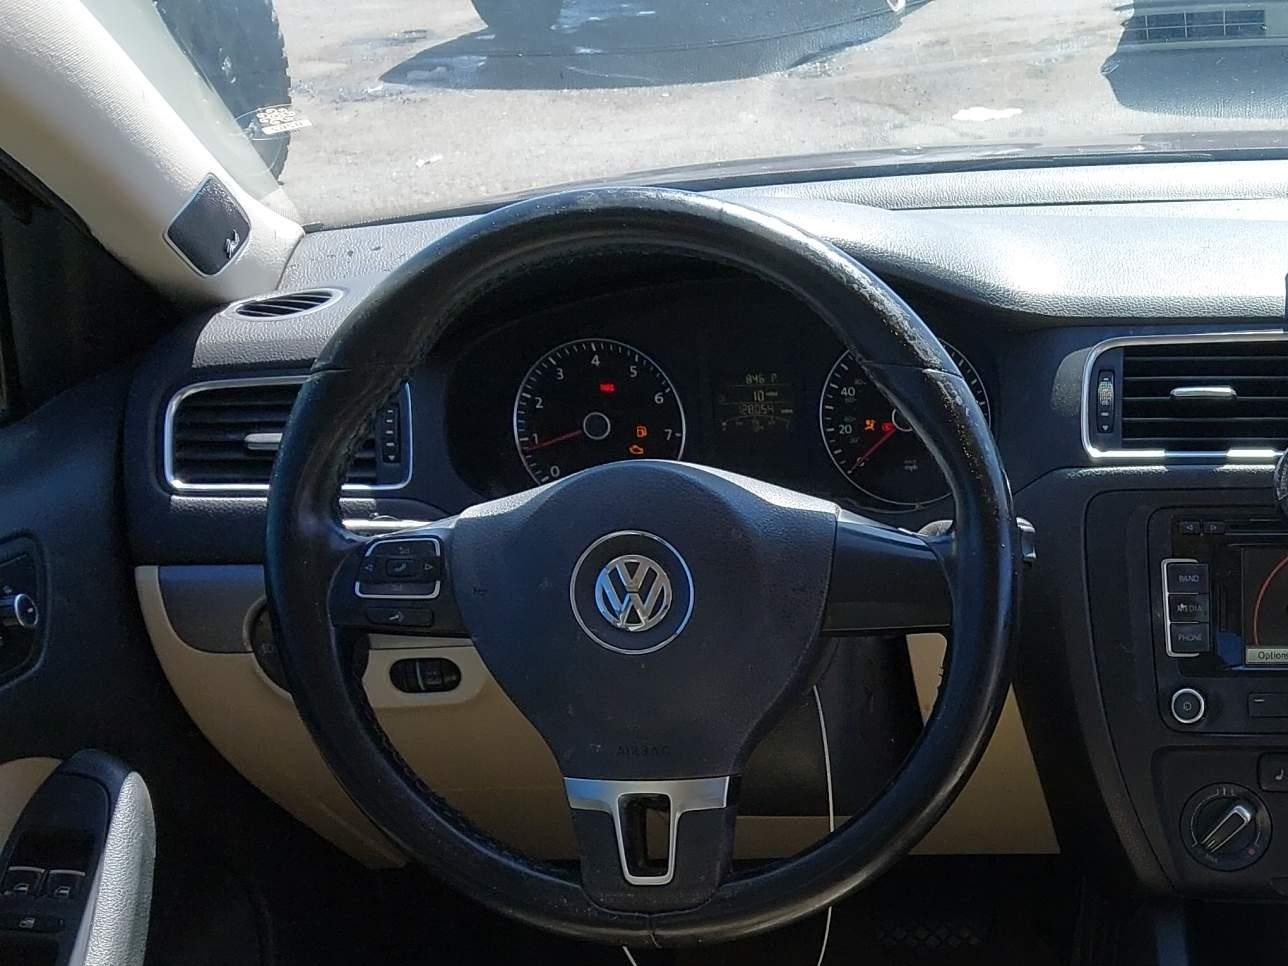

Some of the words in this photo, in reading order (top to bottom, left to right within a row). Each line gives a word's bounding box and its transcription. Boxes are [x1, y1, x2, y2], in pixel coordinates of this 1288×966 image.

[591, 355, 600, 366] 4
[556, 368, 564, 380] 3
[630, 366, 638, 377] 5
[840, 387, 856, 397] 40
[535, 397, 544, 408] 2
[654, 392, 664, 404] 6
[664, 429, 673, 440] 7
[839, 424, 852, 434] 20
[532, 434, 539, 444] 1
[550, 465, 560, 477] 0
[1178, 575, 1200, 583] BAND
